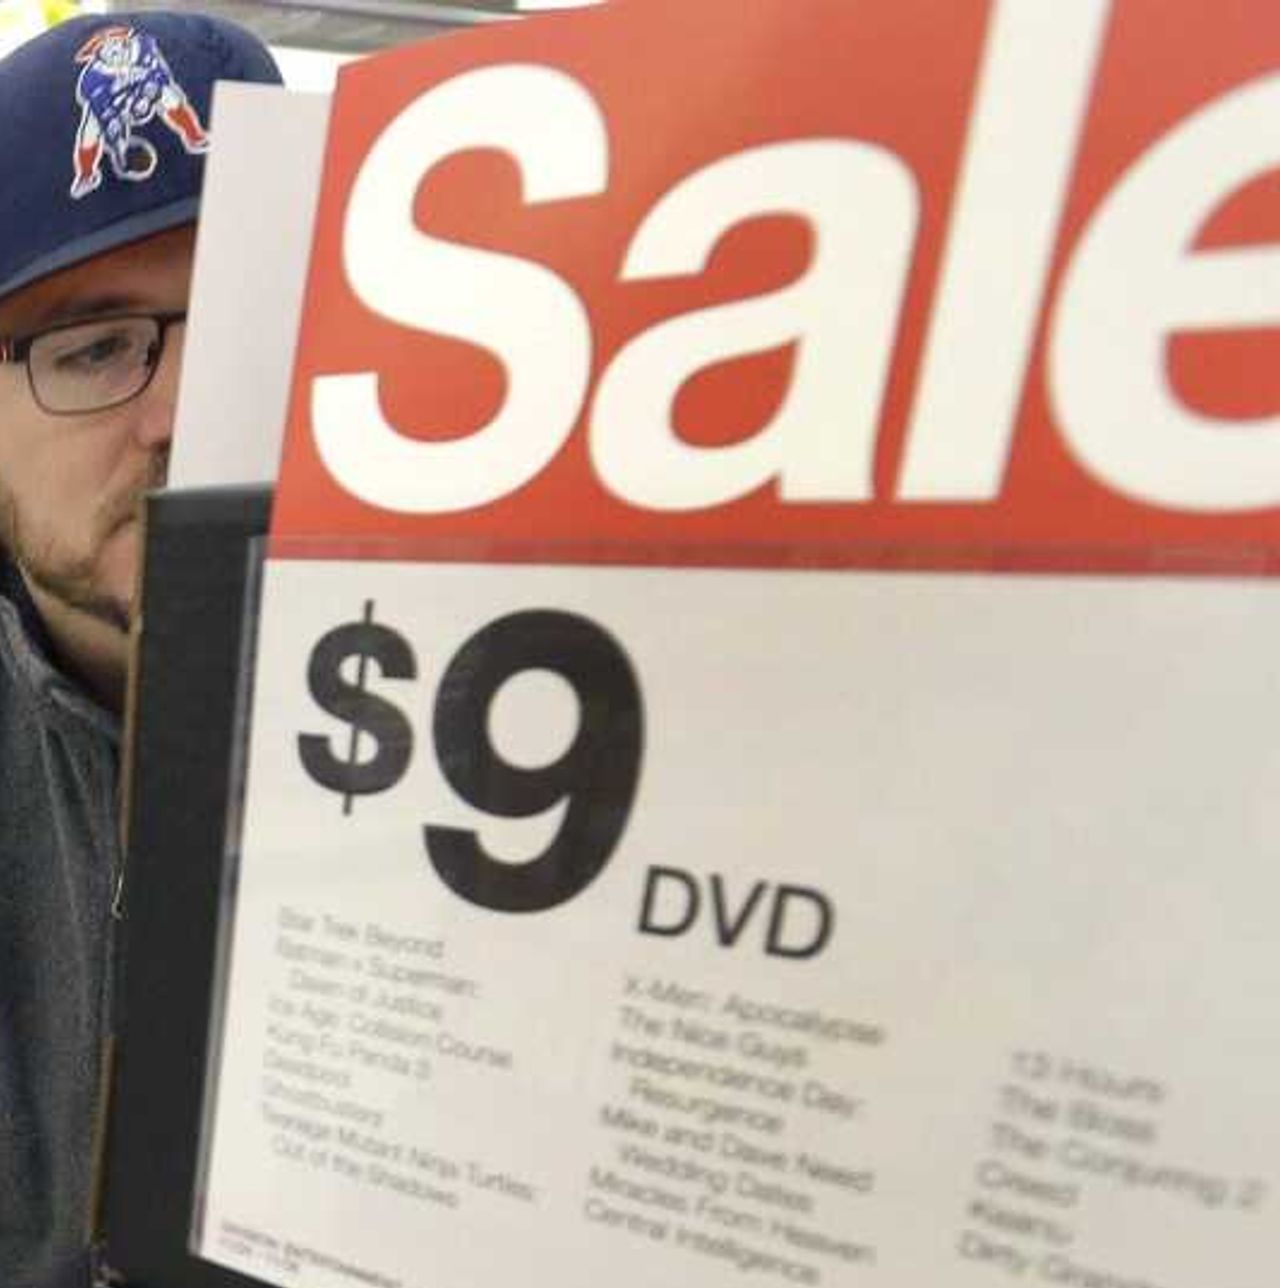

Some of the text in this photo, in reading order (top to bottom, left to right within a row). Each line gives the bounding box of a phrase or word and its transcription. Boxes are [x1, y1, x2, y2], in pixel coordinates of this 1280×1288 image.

[310, 0, 1280, 514] Sale
[296, 599, 835, 962] $9 DVD
[611, 1038, 797, 1103] Independence
